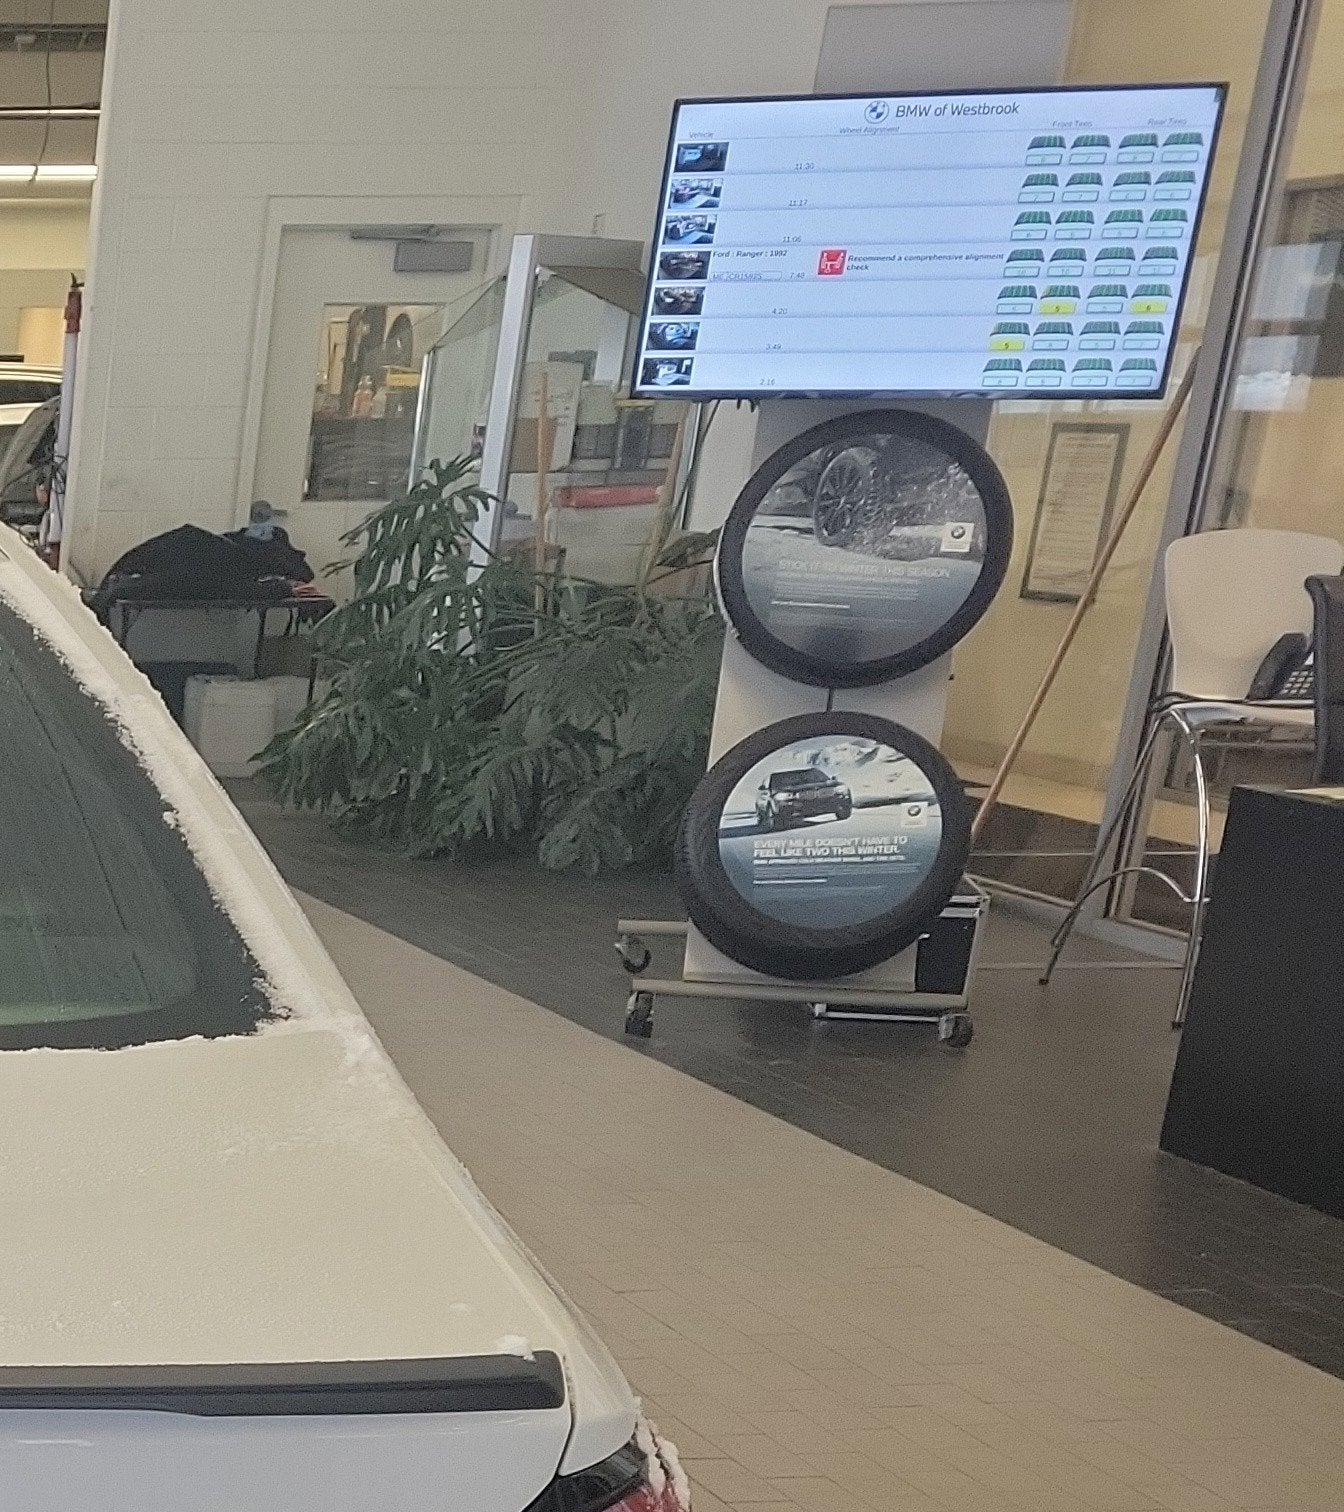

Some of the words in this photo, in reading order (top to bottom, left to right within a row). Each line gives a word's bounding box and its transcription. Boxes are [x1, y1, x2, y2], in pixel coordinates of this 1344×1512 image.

[895, 104, 932, 118] BMW
[934, 103, 949, 116] of
[951, 101, 1020, 116] Westbrook
[713, 250, 730, 258] Ford
[736, 250, 763, 259] Ranger
[848, 254, 896, 262] Recommend
[904, 253, 963, 262] comprehensive
[965, 253, 1005, 262] alignment
[846, 263, 869, 271] check
